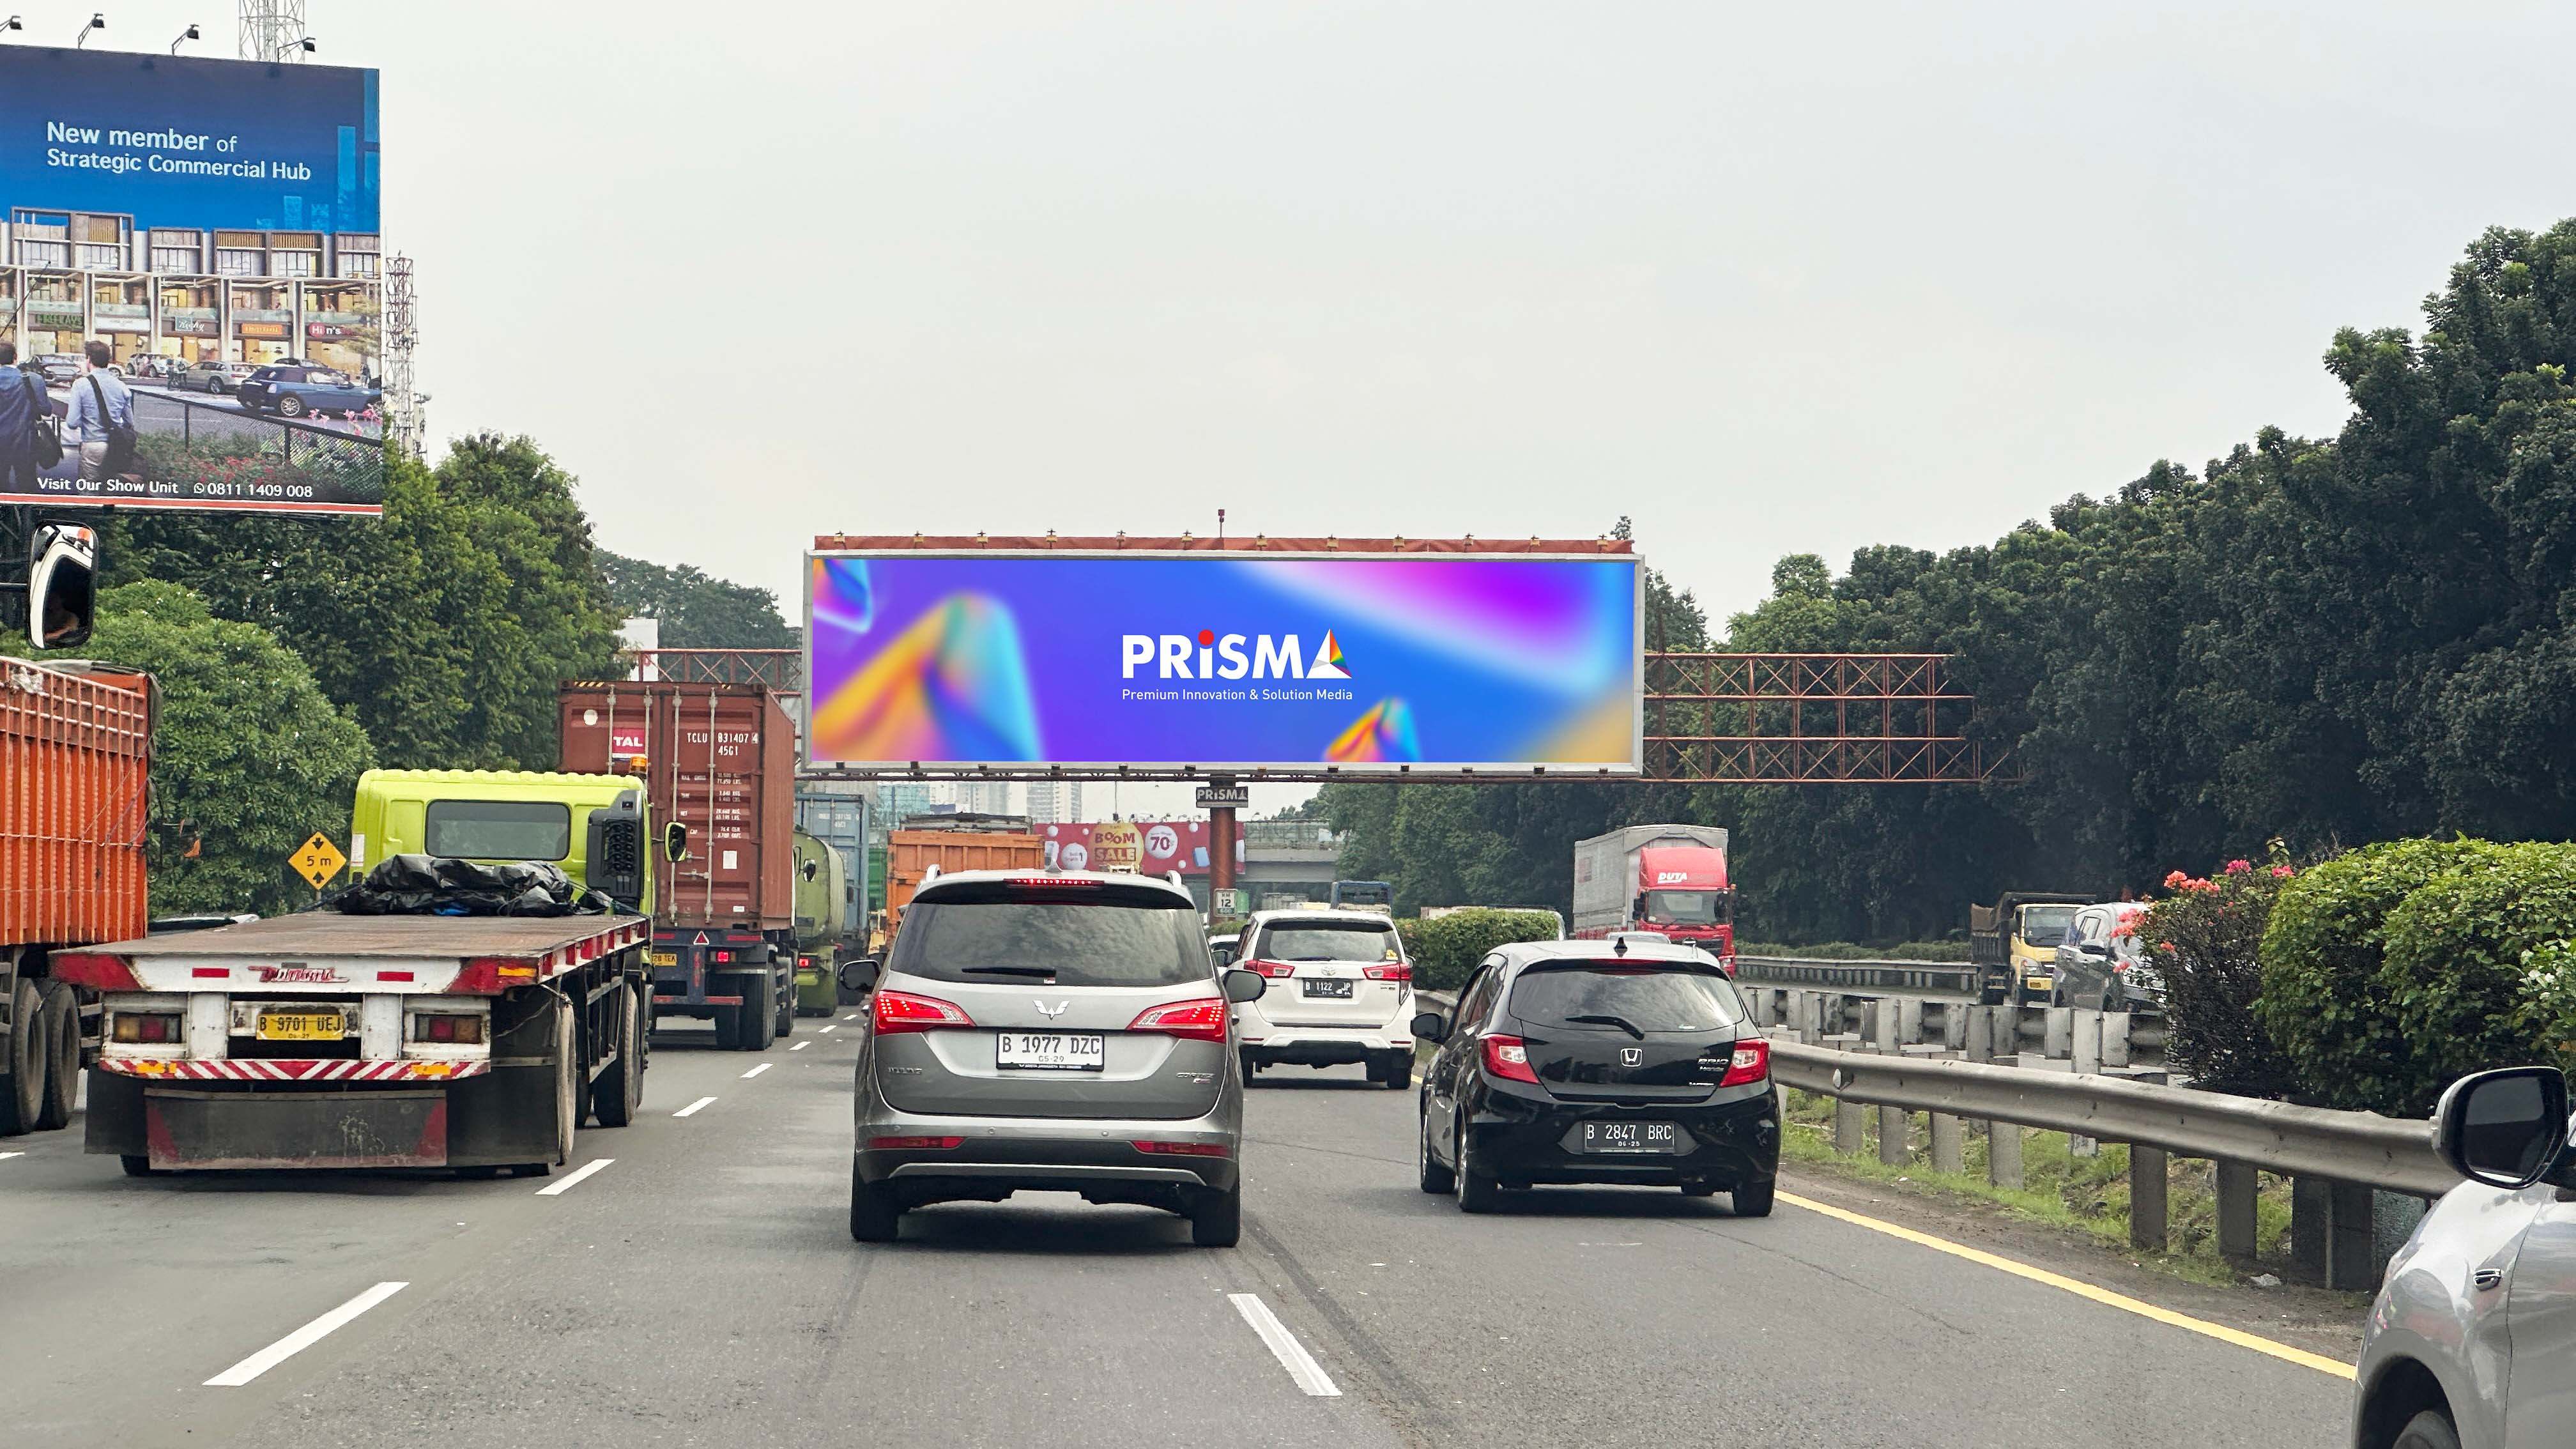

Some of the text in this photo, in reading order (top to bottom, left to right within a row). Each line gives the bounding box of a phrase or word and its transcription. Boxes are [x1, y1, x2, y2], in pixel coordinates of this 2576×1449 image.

[47, 121, 238, 153] New member of
[47, 148, 311, 180] Strategic Commercial Hub
[37, 477, 179, 494] Visit Our Show Unit
[207, 482, 312, 497] 0811 1409 008
[1123, 689, 1353, 700] Premium Innovation & Solution Media
[613, 736, 643, 747] TAL
[687, 733, 707, 742] TCLU
[718, 746, 738, 755] 45G1
[307, 855, 314, 866] 5
[1094, 848, 1137, 862] SALE
[1657, 872, 1687, 882] DUTA
[1221, 899, 1231, 907] 12
[1305, 981, 1310, 990] B
[1316, 981, 1333, 991] 1122
[259, 1016, 341, 1031] B 9701 UEJ
[1002, 1036, 1100, 1054] B 1977 DZC
[1587, 1124, 1672, 1140] B 2847 BRC
